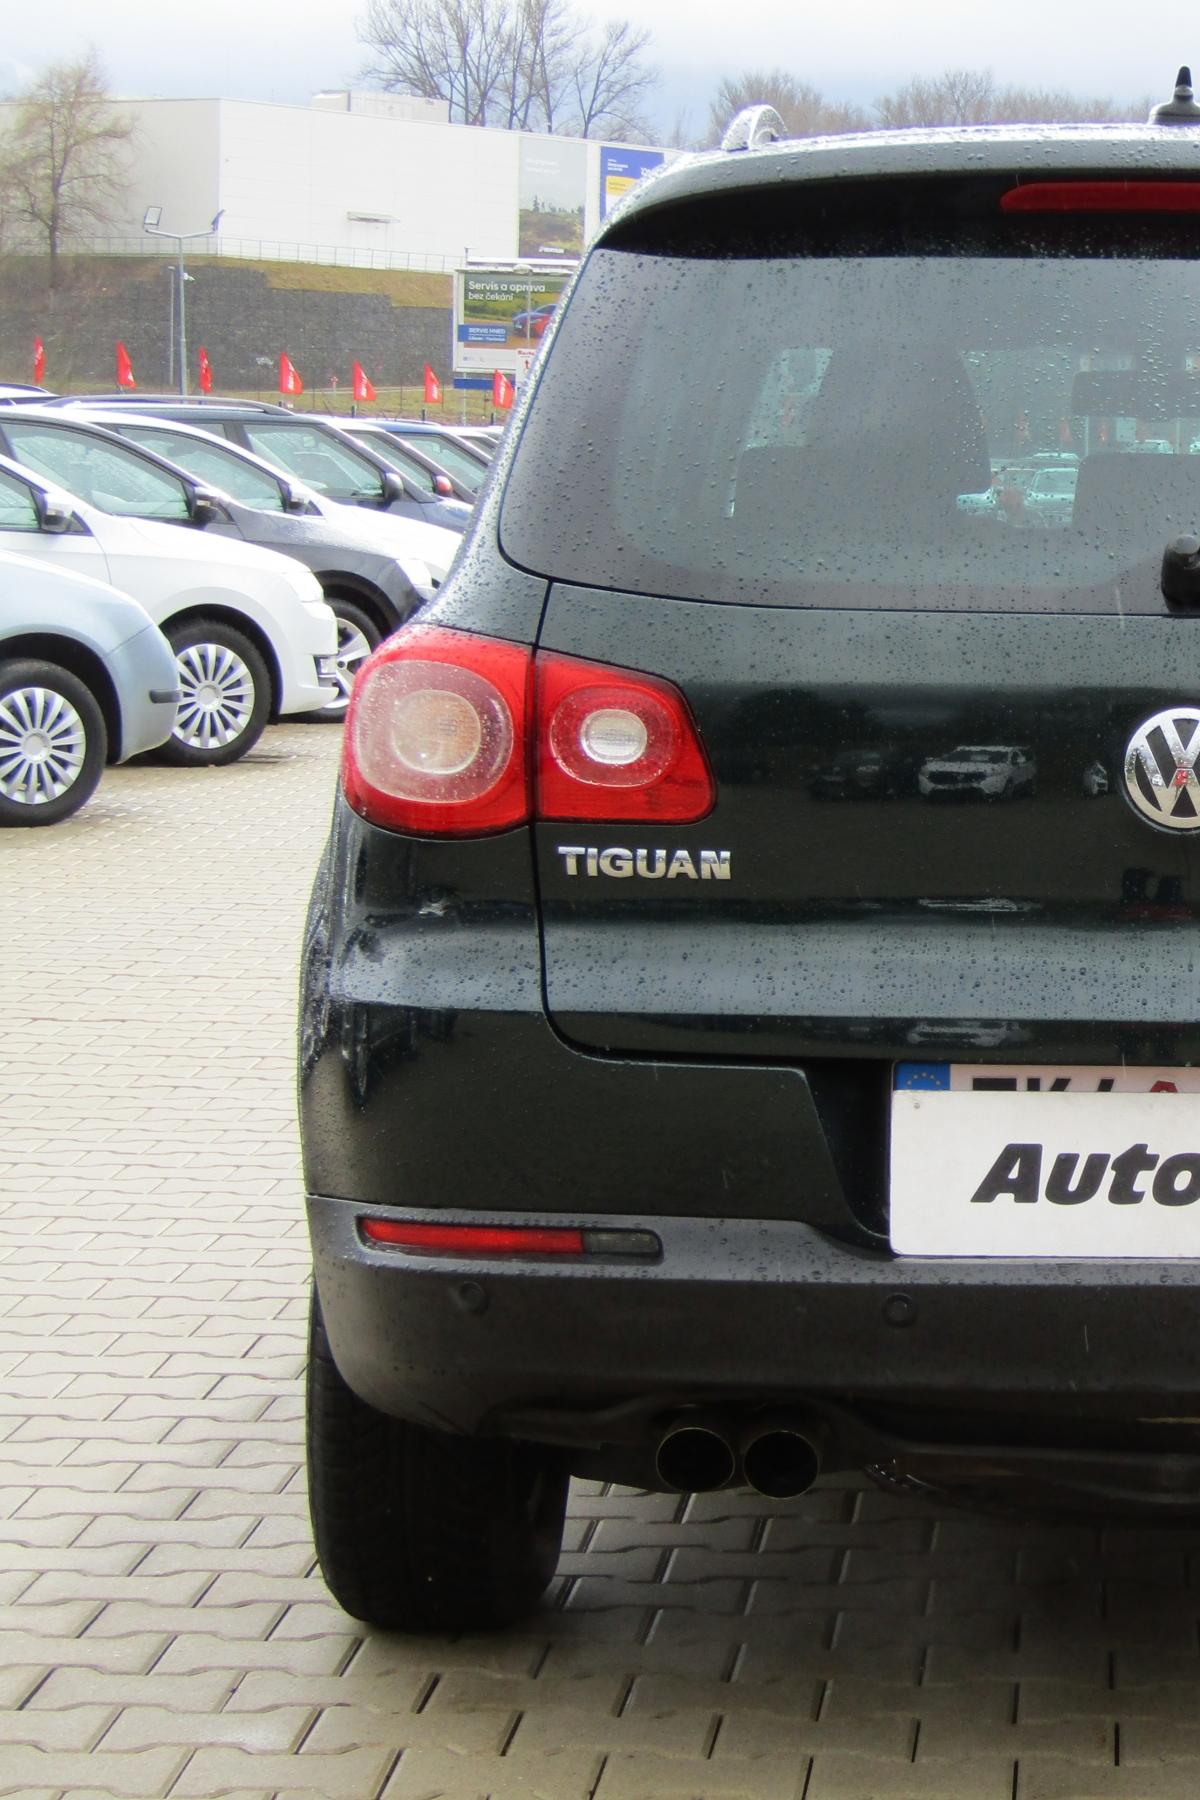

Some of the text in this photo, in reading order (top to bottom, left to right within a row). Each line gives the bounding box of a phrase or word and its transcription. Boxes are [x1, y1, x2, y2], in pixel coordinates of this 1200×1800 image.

[468, 280, 499, 291] Servis
[468, 291, 484, 300] bez
[558, 846, 731, 880] TIGUAN
